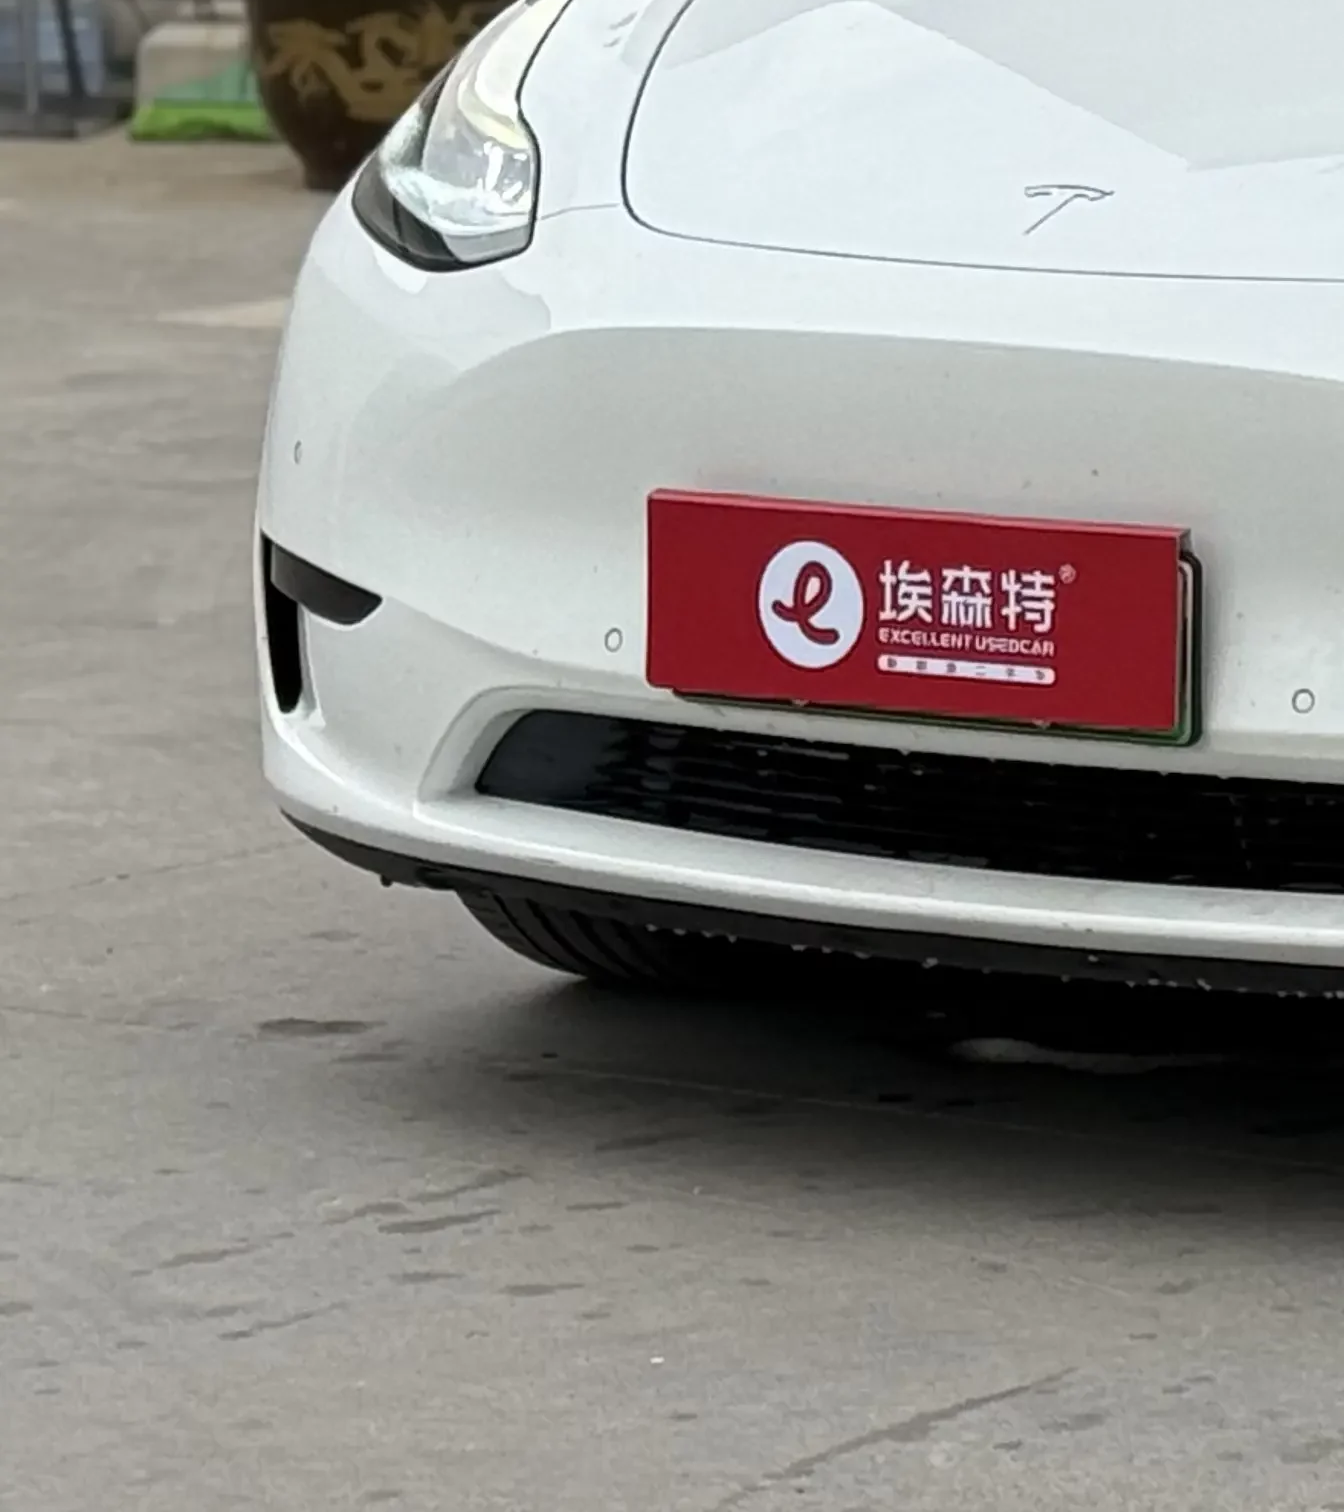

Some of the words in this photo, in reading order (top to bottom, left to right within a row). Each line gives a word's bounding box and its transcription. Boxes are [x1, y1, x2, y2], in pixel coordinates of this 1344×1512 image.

[879, 559, 1056, 633] 埃森特
[879, 627, 972, 650] EXCELLENT
